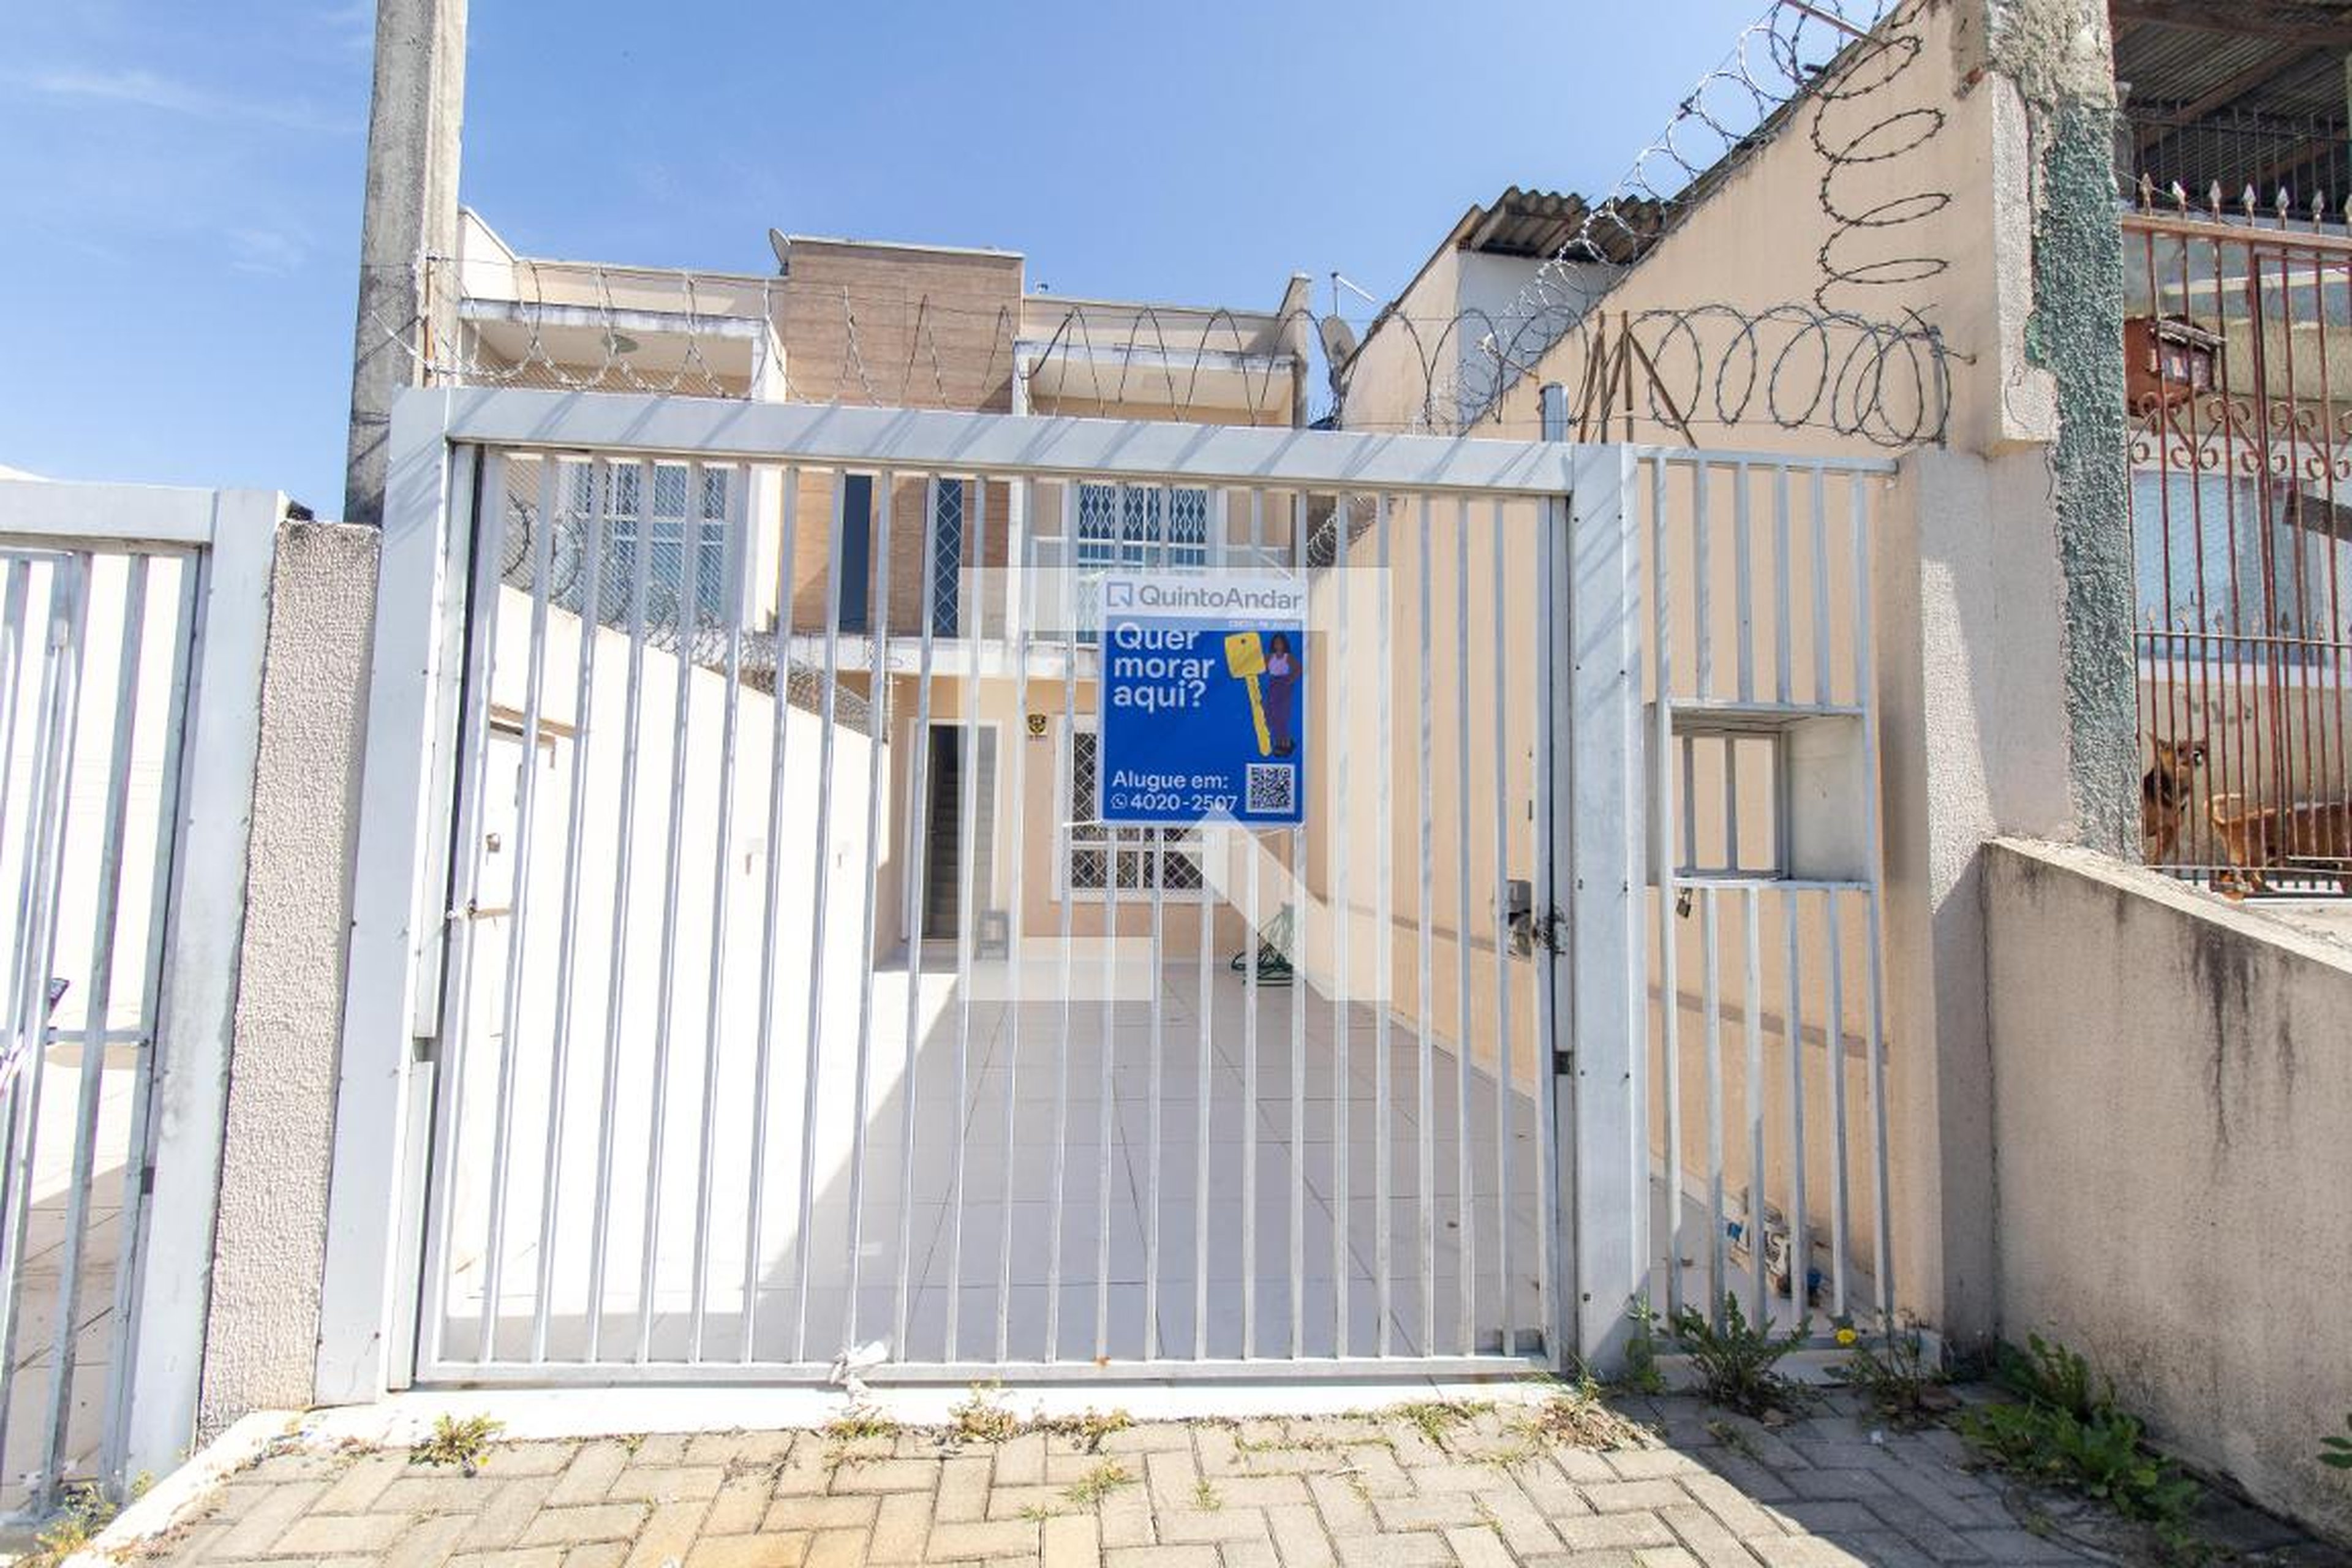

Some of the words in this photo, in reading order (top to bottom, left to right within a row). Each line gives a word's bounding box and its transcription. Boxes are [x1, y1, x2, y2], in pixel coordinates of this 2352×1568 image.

[1139, 585, 1302, 609] QuintoAndar
[1114, 622, 1200, 650] Quer
[1114, 657, 1215, 679] morar
[1113, 679, 1207, 713] aqui?
[1112, 770, 1186, 792] Alugue
[1191, 774, 1229, 789] em:
[1131, 794, 1238, 812] 4020-2507
